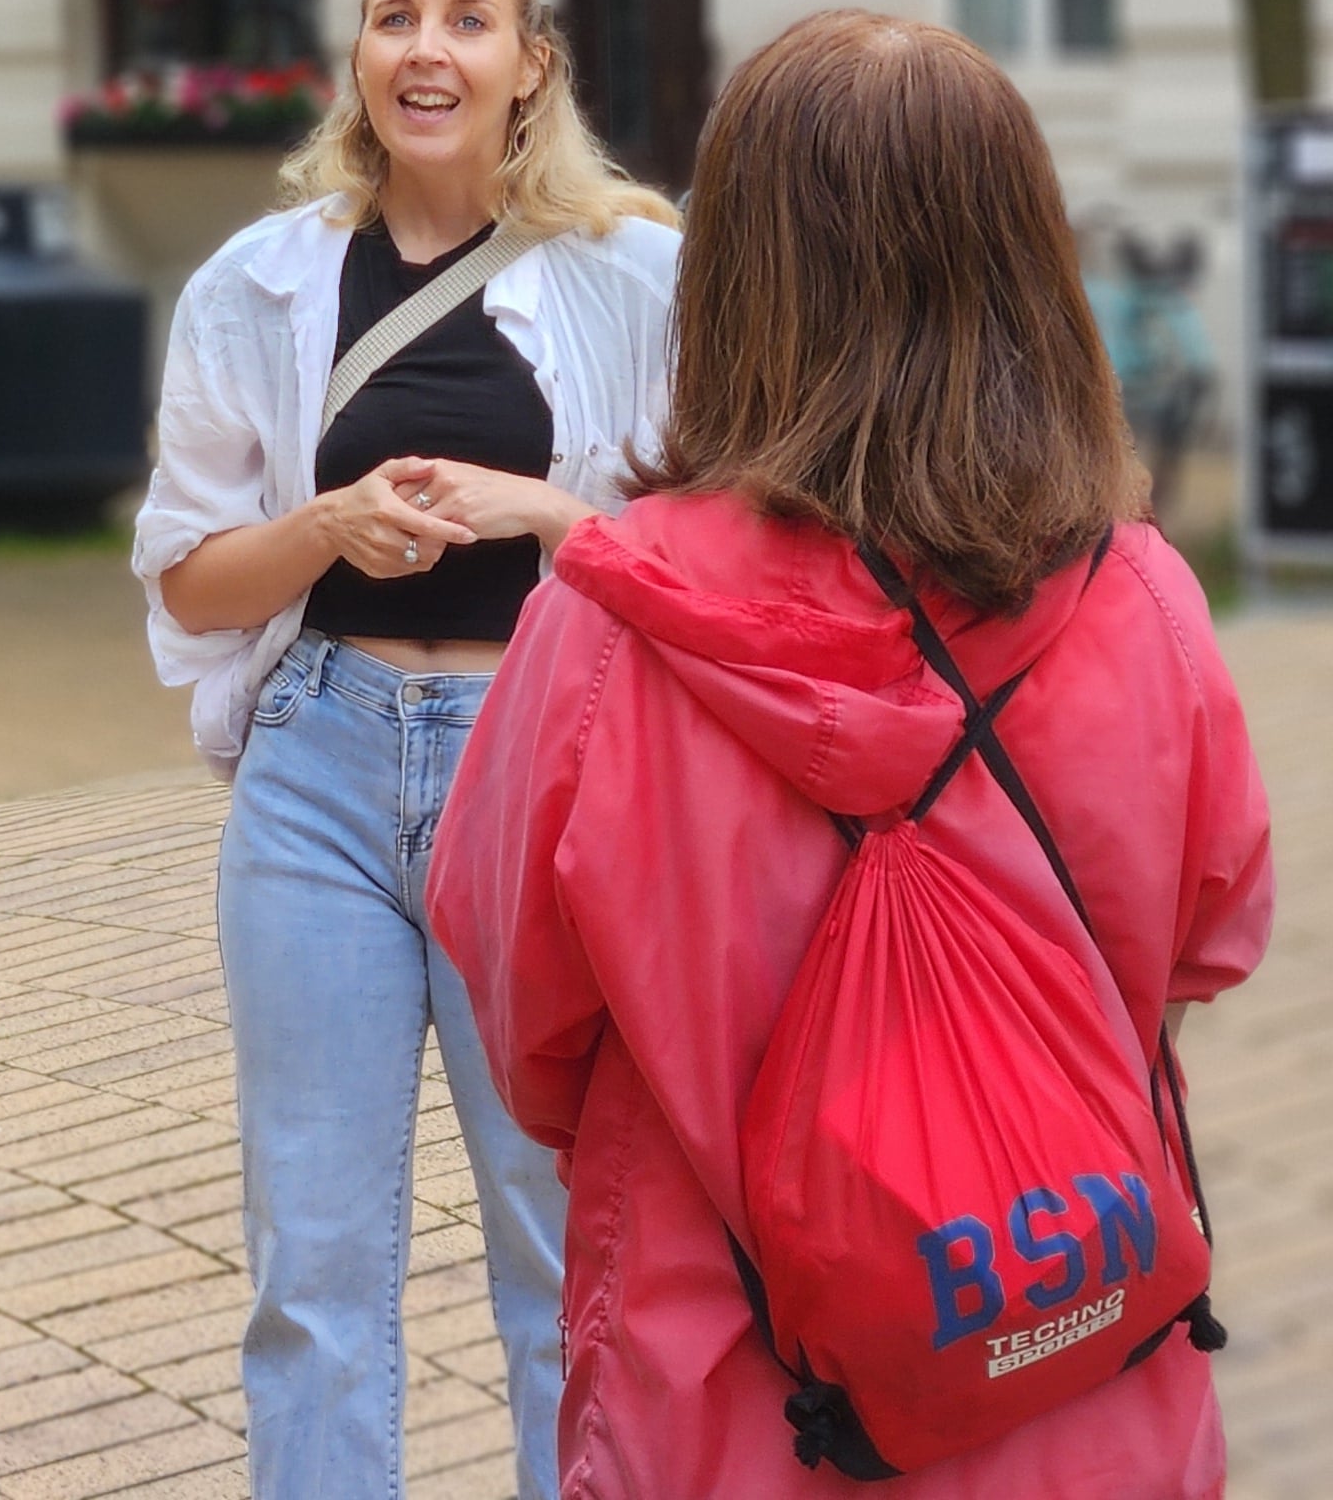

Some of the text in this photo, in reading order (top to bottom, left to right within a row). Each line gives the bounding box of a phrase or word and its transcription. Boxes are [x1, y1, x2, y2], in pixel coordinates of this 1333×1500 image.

[916, 1171, 1159, 1353] BSN
[986, 1288, 1125, 1356] TECHNO
[996, 1311, 1117, 1373] SPORTS
